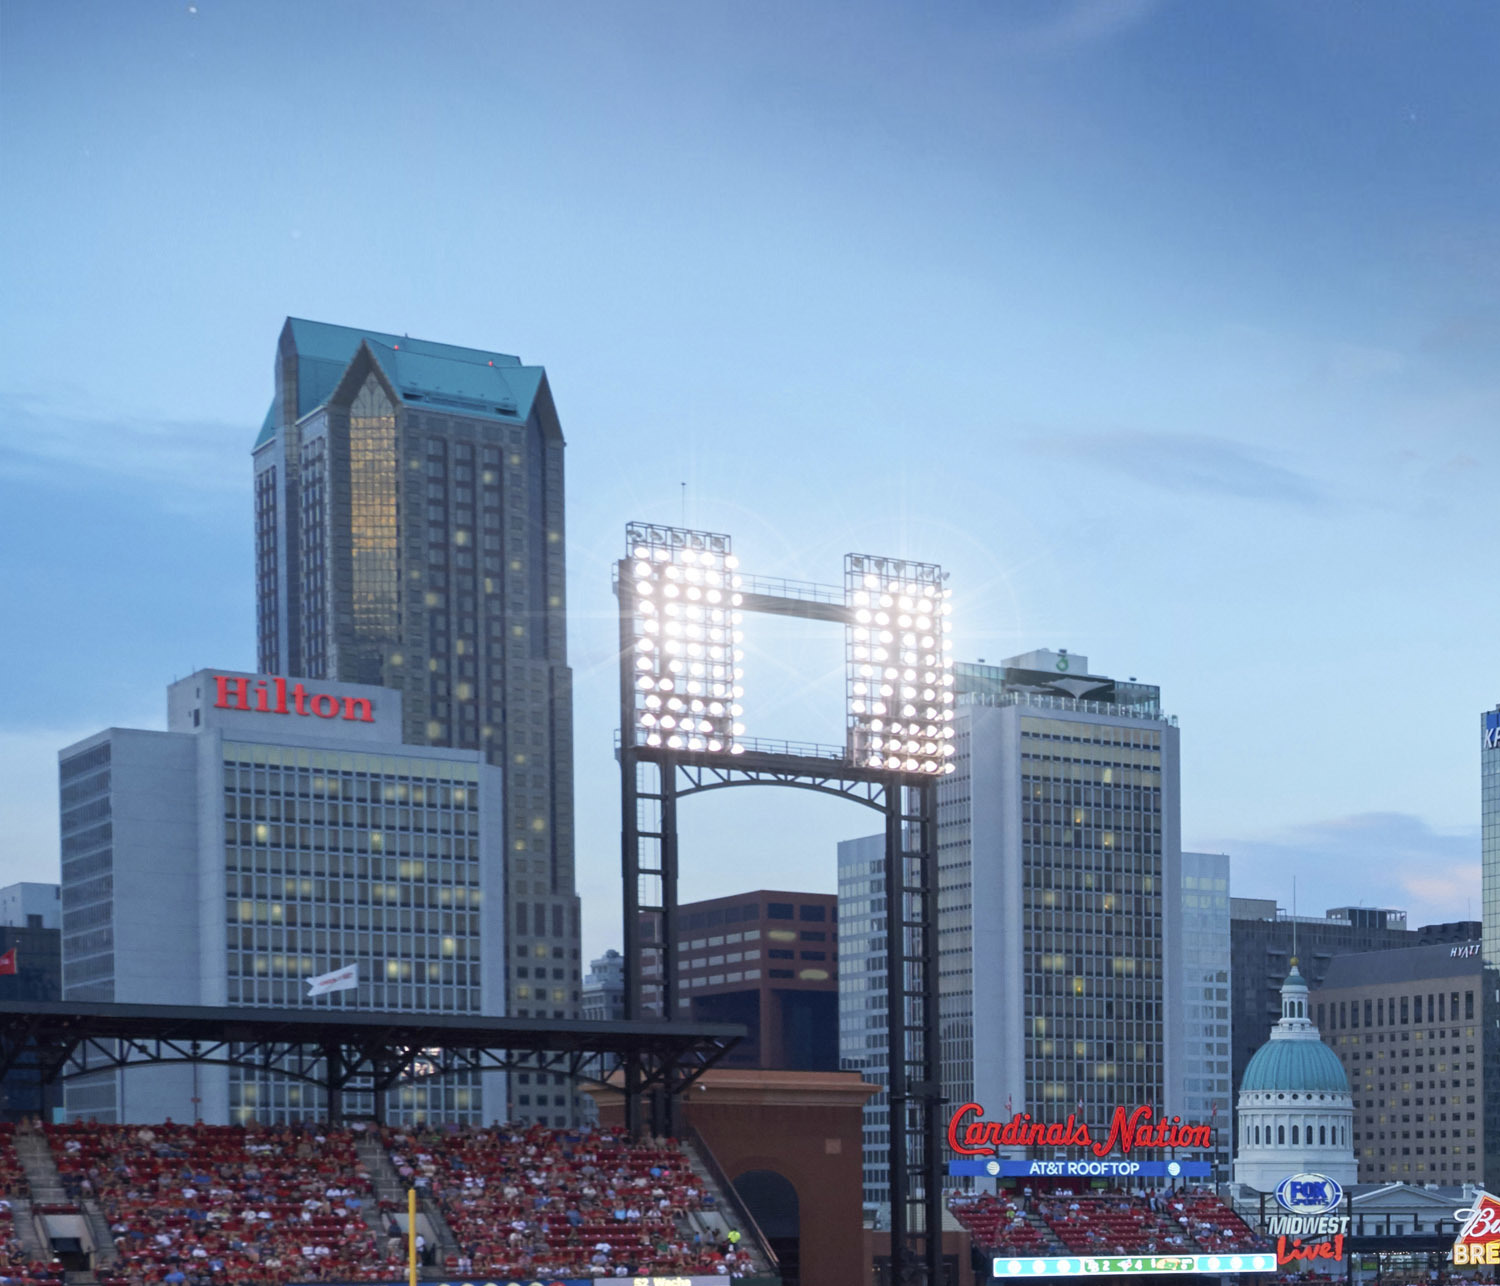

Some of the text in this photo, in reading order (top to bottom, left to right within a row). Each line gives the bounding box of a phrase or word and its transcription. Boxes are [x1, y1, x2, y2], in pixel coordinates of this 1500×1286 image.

[213, 675, 375, 722] Hilton
[948, 1103, 1211, 1156] Cardinals Nation
[1030, 1162, 1140, 1175] AT&T ROOFTOP
[1290, 1182, 1328, 1199] FOX
[1268, 1216, 1350, 1235] MIDWEST
[1276, 1233, 1344, 1265] Live!
